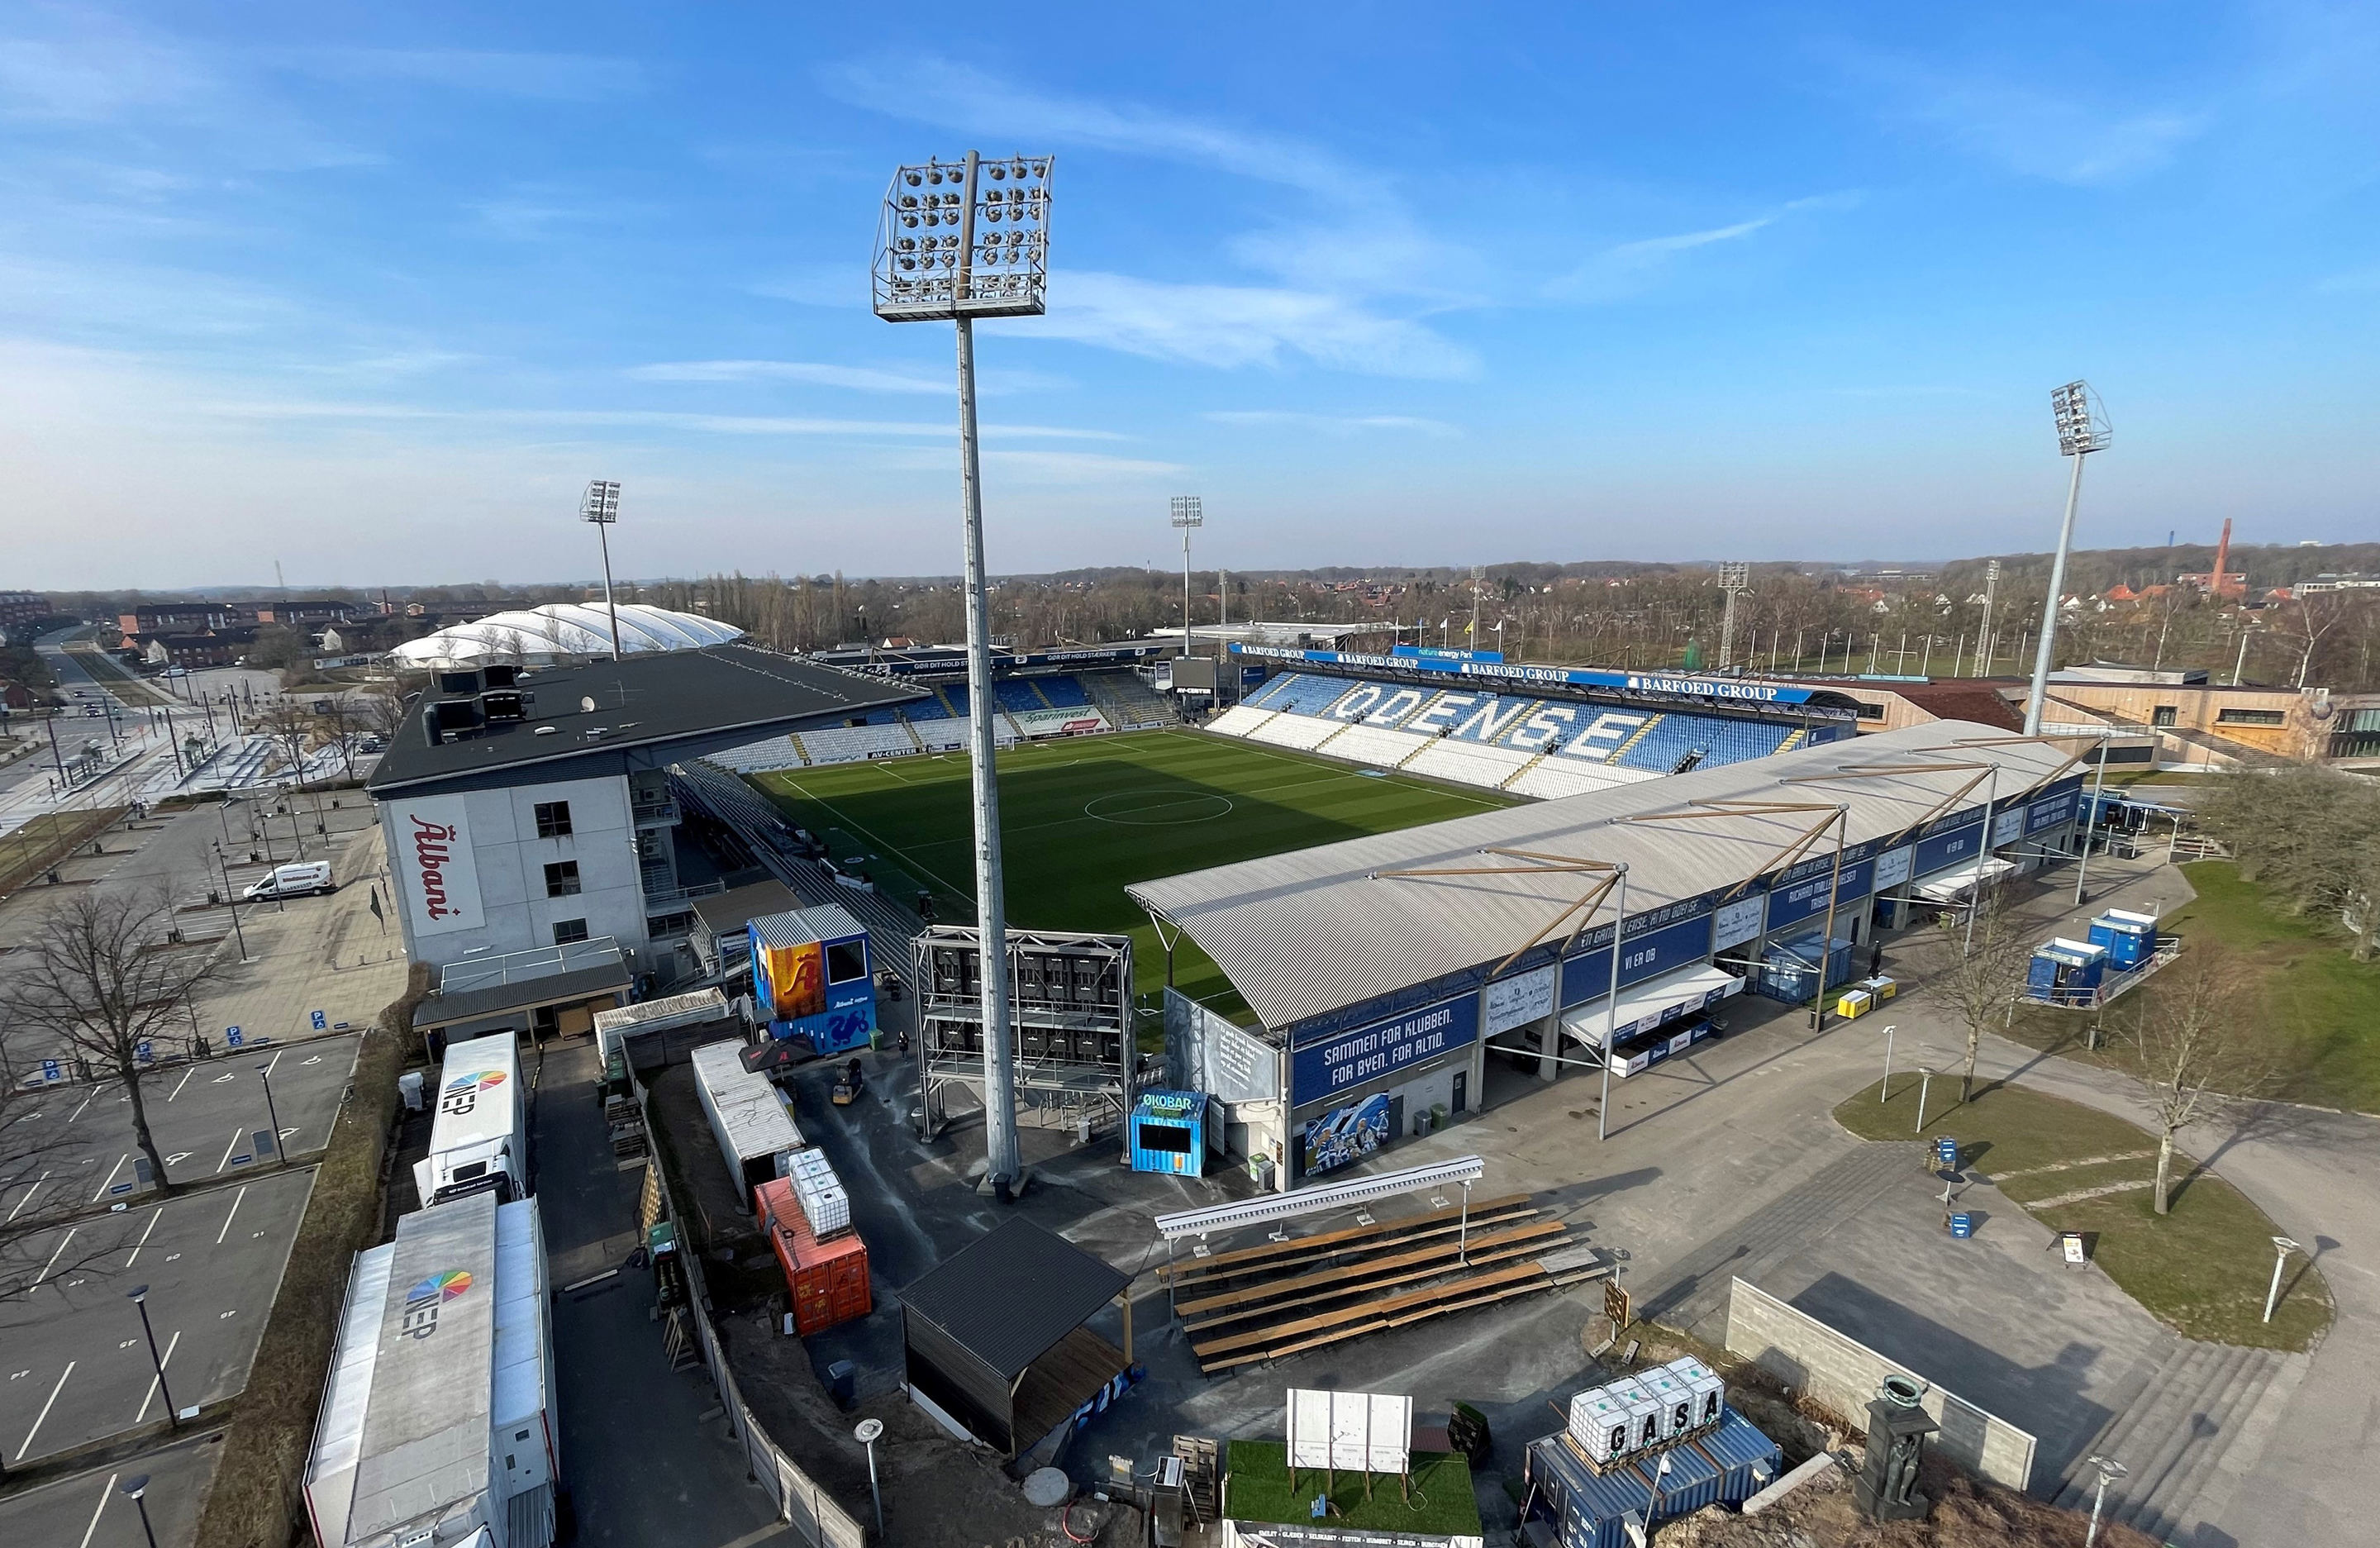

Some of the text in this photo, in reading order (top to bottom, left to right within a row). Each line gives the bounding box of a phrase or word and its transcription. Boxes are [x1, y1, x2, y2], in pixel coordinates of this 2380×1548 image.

[1248, 645, 1305, 660] BARFOED GROUP
[1345, 654, 1419, 669] BARFOED GROUP
[1460, 650, 1473, 659] Park
[1472, 664, 1569, 682] BARFOED GROUP
[1642, 678, 1778, 701] BARFOED GROUP
[1026, 707, 1091, 724] Sparinvest
[1334, 686, 1646, 759] ODENSE
[410, 814, 460, 921] Albani
[1625, 948, 1656, 970] VI ER OB
[314, 1012, 321, 1020] P
[230, 1027, 238, 1036] P
[1324, 1035, 1378, 1066] SAMMEN
[1381, 1026, 1401, 1046] FOR
[1405, 1008, 1453, 1038] KLUBBEN.
[1332, 1032, 1445, 1086] FOR BYEN. FOR ALTID.
[440, 1084, 476, 1117] NEP
[1143, 1093, 1192, 1110] ØKOBAR
[402, 1291, 440, 1341] NEP
